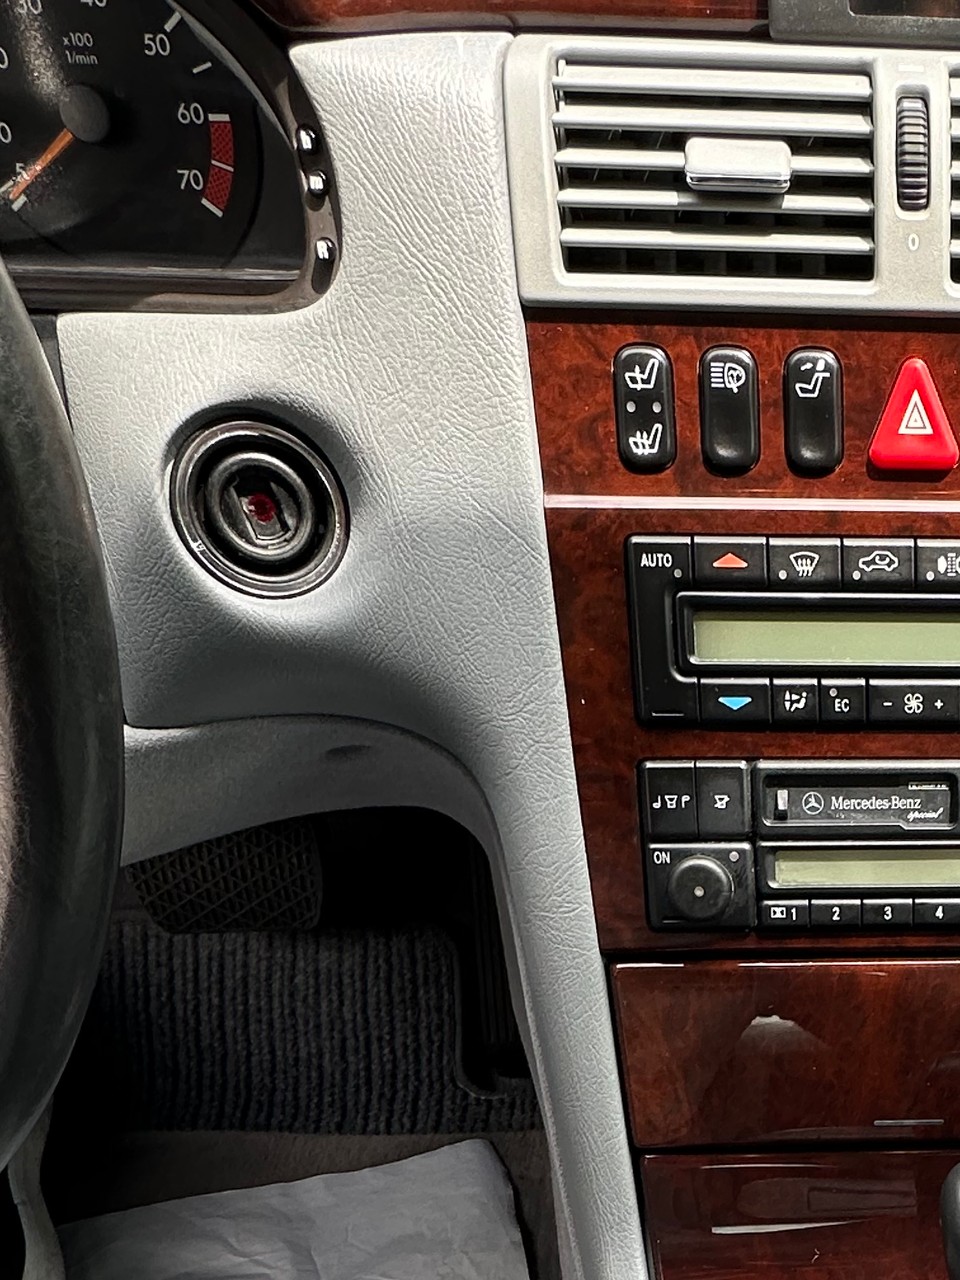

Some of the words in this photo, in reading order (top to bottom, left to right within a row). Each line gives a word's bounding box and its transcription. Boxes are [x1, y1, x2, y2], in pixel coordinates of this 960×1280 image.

[62, 32, 93, 47] x100
[144, 34, 170, 56] 50
[65, 50, 98, 64] 1/min
[177, 103, 204, 124] 60
[177, 169, 204, 190] 70
[640, 553, 672, 568] AUTO
[834, 699, 850, 713] EC
[653, 851, 671, 864] ON
[791, 908, 797, 920] 1
[832, 907, 841, 921] 2
[883, 906, 893, 920] 3
[935, 906, 944, 919] 4
